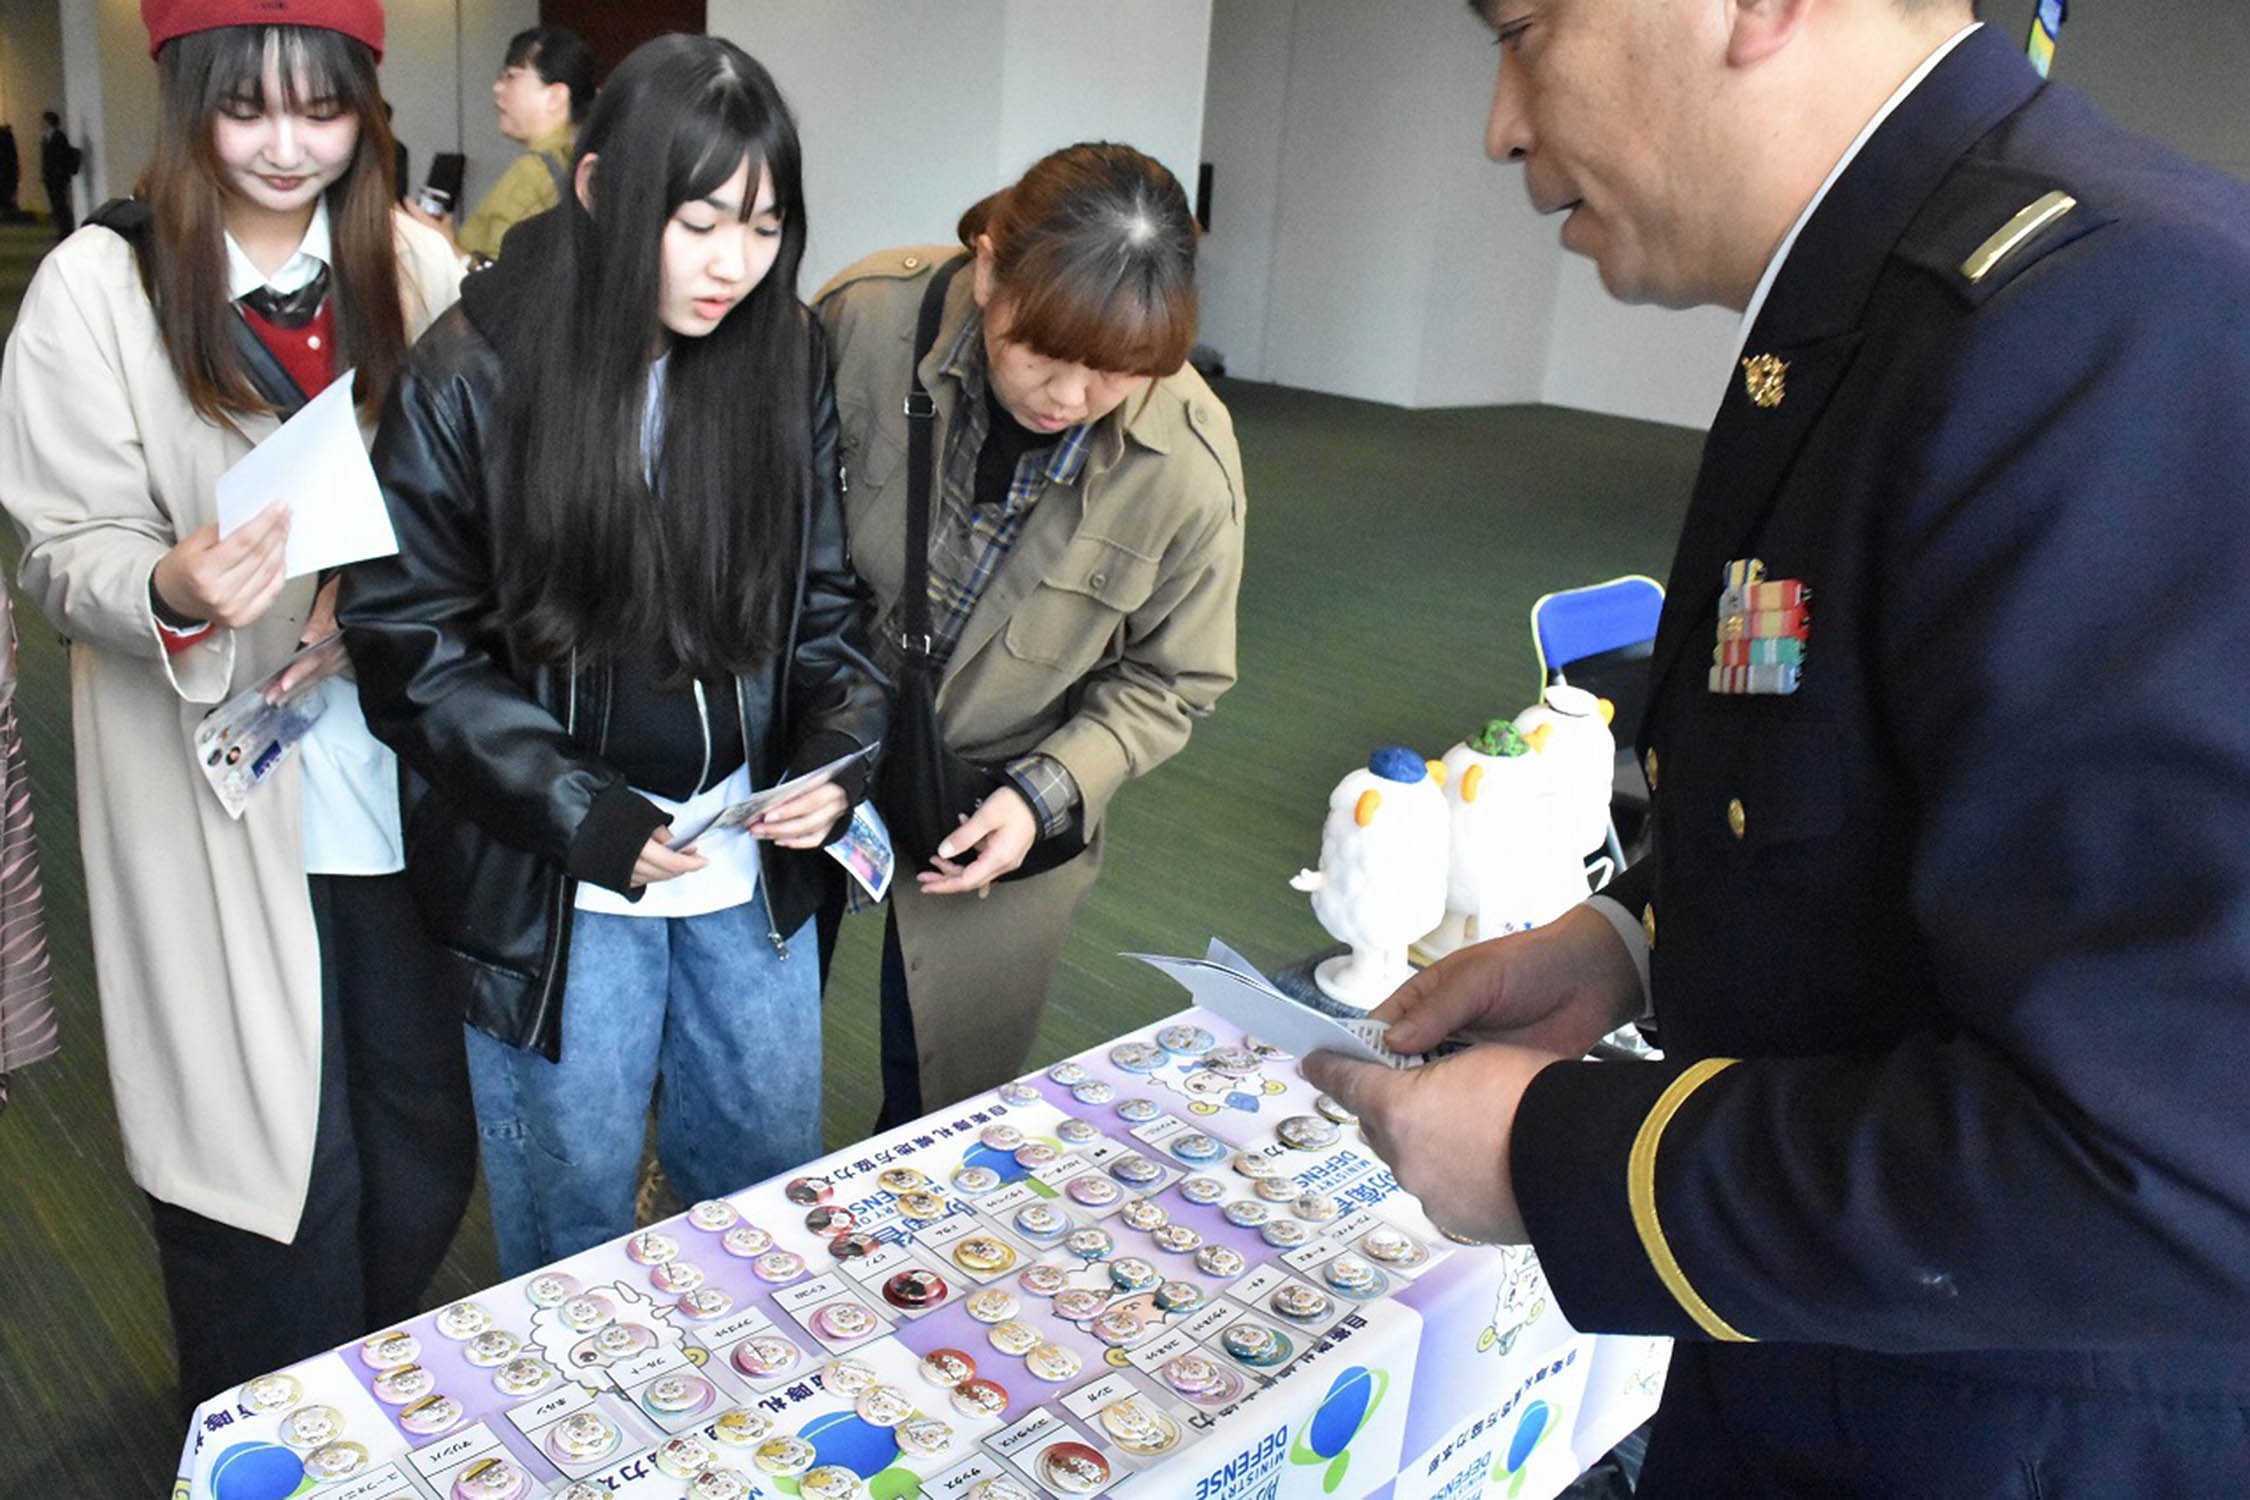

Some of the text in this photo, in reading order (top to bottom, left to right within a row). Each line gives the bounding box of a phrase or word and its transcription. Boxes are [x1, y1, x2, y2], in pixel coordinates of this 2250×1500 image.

[1292, 1149, 1359, 1189] DEFENS
[935, 1224, 960, 1237] ドラム
[865, 1253, 888, 1268] ピアノ
[713, 1317, 755, 1338] ファゴット
[630, 1357, 667, 1376] フルート
[1086, 1386, 1115, 1403] コンガ
[535, 1398, 568, 1417] ホルン
[999, 1418, 1050, 1449] コントラバス
[429, 1439, 473, 1463] マリンバ
[1195, 1424, 1288, 1500] DEFENSE
[338, 1471, 399, 1500] ユーフォニ
[943, 1467, 982, 1491] サックス
